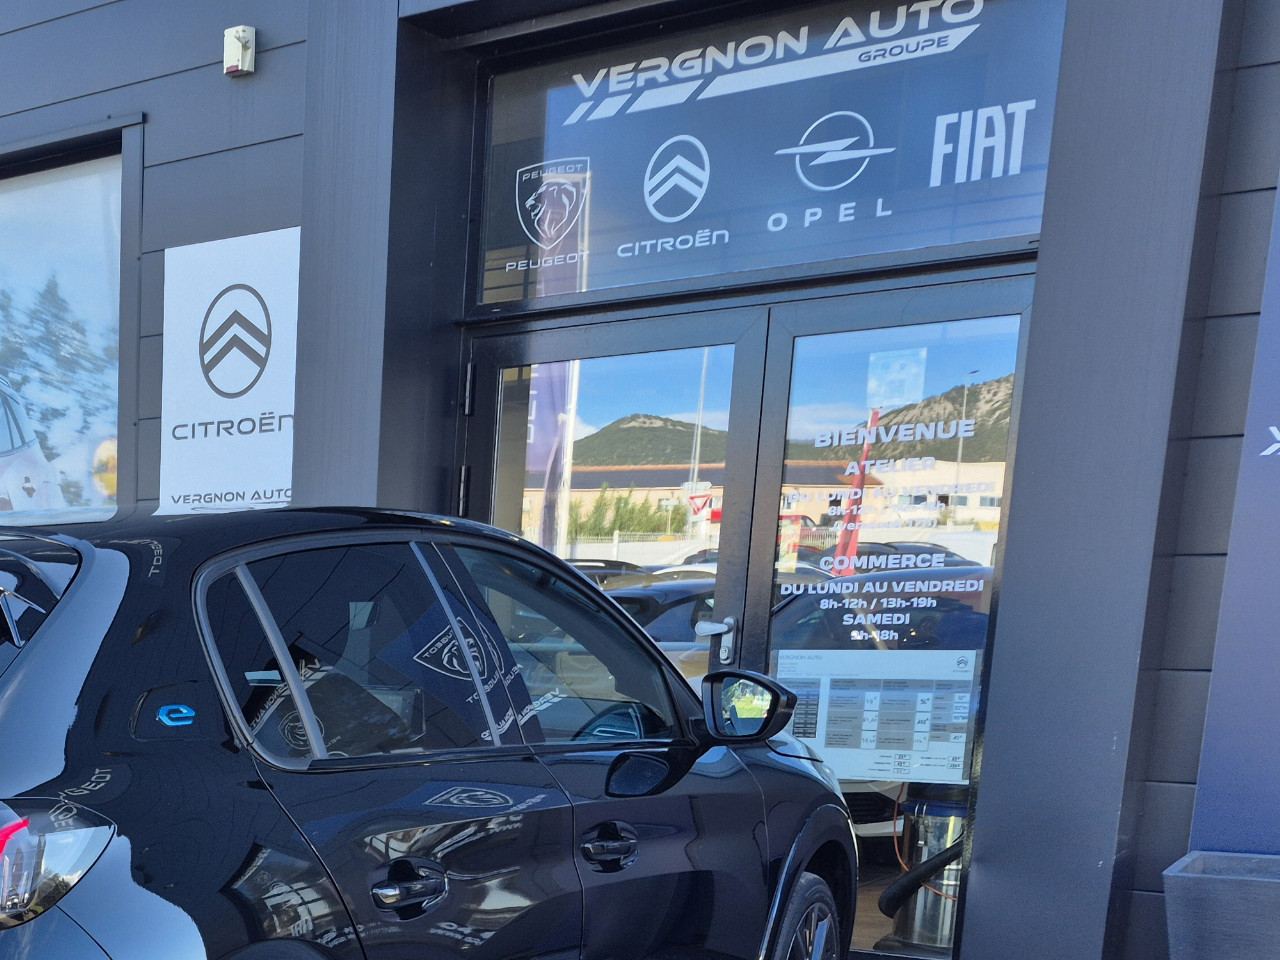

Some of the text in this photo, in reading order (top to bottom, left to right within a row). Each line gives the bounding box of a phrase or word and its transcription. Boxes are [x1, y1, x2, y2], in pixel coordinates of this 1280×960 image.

[572, 0, 985, 98] VERGNON AUTO
[858, 35, 950, 63] GROUPE
[929, 99, 1036, 187] FIAT
[522, 163, 584, 182] PEUGEOT
[767, 198, 892, 232] OPEL
[505, 251, 590, 272] PEUGEOT
[814, 420, 975, 448] BIENVENUE
[844, 457, 936, 476] ATELIER
[171, 491, 245, 504] VERGNON
[816, 488, 866, 501] LUNDI
[902, 481, 994, 497] VENDREDI
[820, 553, 945, 570] COMMERCE
[781, 579, 984, 595] DU LUNDI AU VENDREDI
[820, 598, 867, 610] 8h-12h
[881, 597, 936, 609] 13h-19h
[842, 613, 910, 625] SAMEDI
